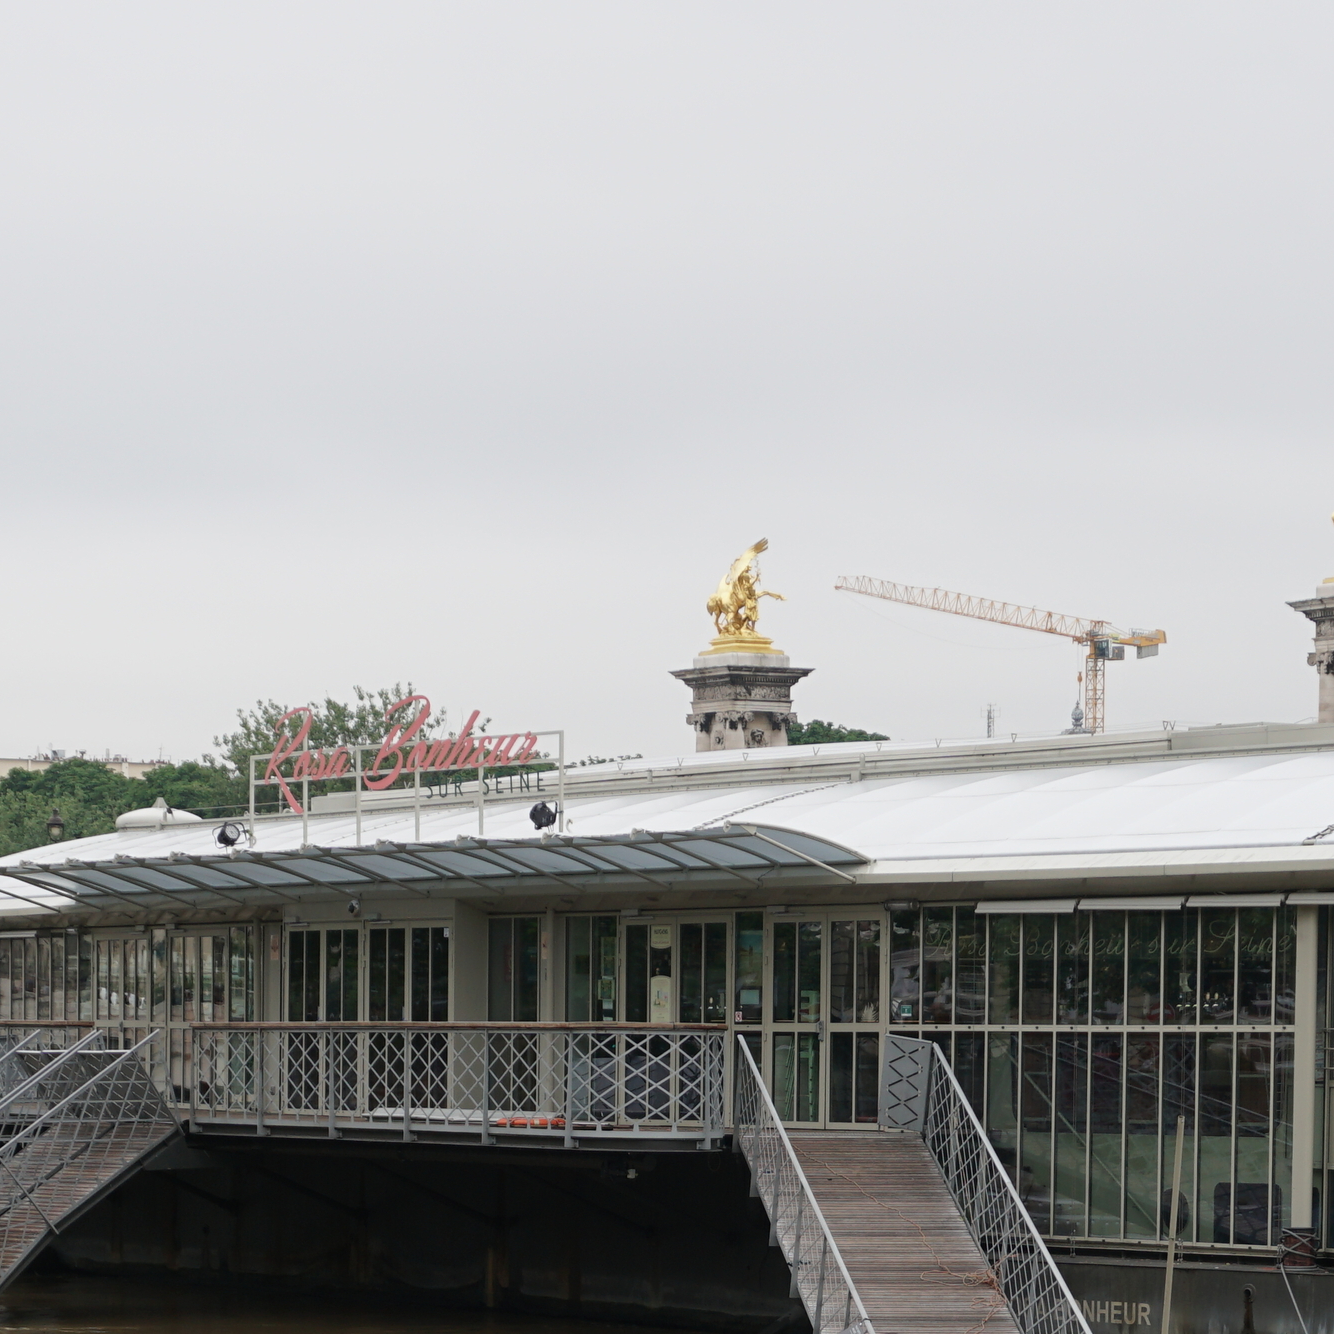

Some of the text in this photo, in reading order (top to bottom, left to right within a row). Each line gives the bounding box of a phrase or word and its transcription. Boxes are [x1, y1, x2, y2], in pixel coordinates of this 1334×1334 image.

[264, 695, 538, 814] Rosa Bonheur
[426, 771, 546, 799] SUR SEINE
